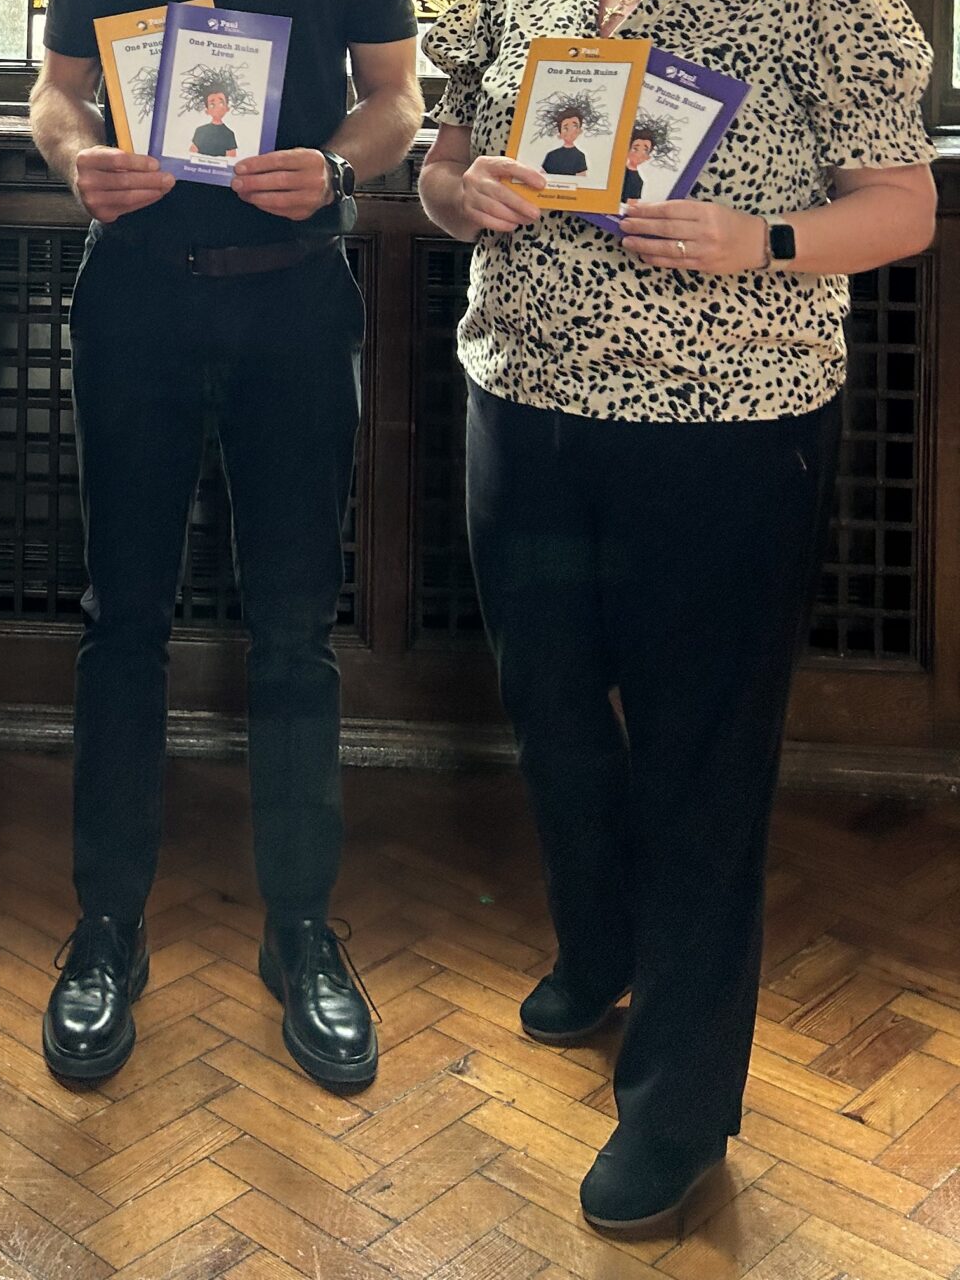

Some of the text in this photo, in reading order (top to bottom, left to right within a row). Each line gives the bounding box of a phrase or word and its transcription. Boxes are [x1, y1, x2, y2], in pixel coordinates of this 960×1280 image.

[220, 20, 238, 28] Paul
[207, 41, 232, 50] Punch
[235, 42, 258, 53] Ruins
[212, 49, 234, 58] Lives
[656, 87, 706, 111] Punch Ruins
[657, 96, 679, 110] Lives
